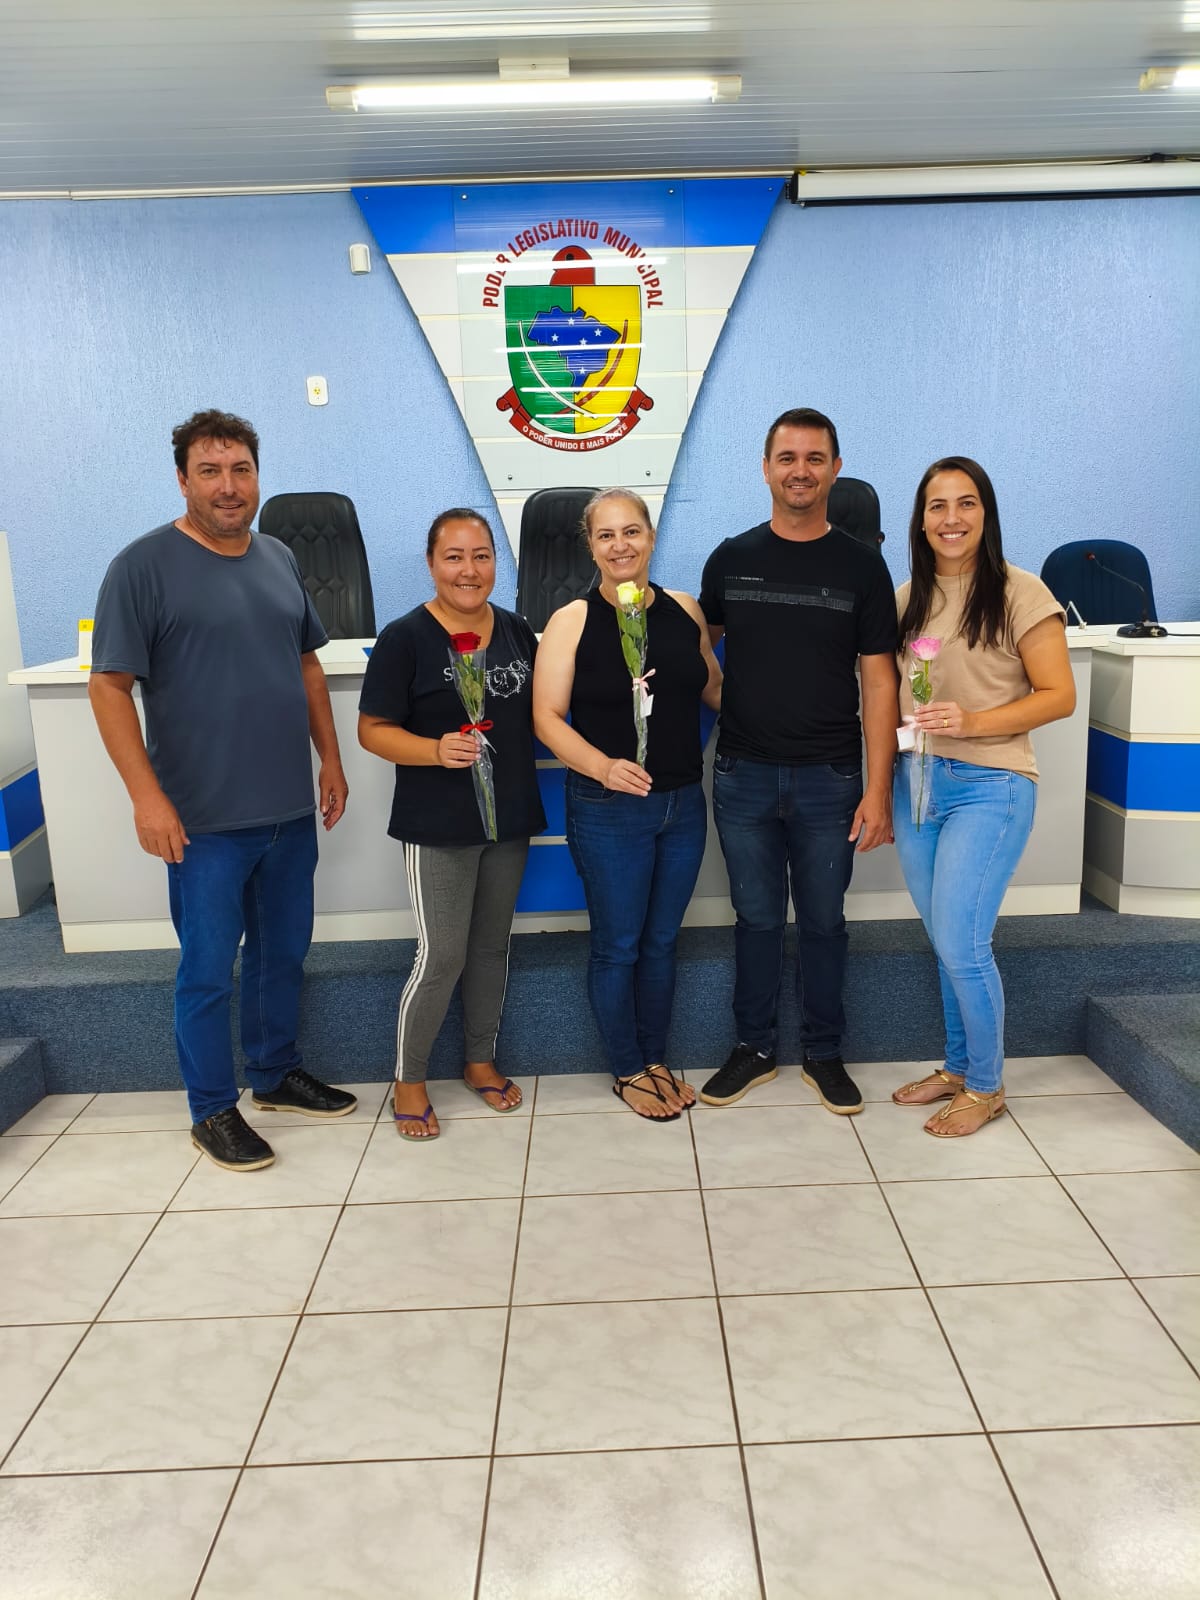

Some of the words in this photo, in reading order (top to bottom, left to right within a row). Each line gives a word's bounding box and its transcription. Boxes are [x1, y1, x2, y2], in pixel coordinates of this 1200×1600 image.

[507, 218, 600, 257] LEGISLATIVO
[529, 430, 553, 446] PODER
[554, 440, 578, 450] UNIDO
[579, 441, 585, 450] É
[586, 438, 604, 449] MAIS
